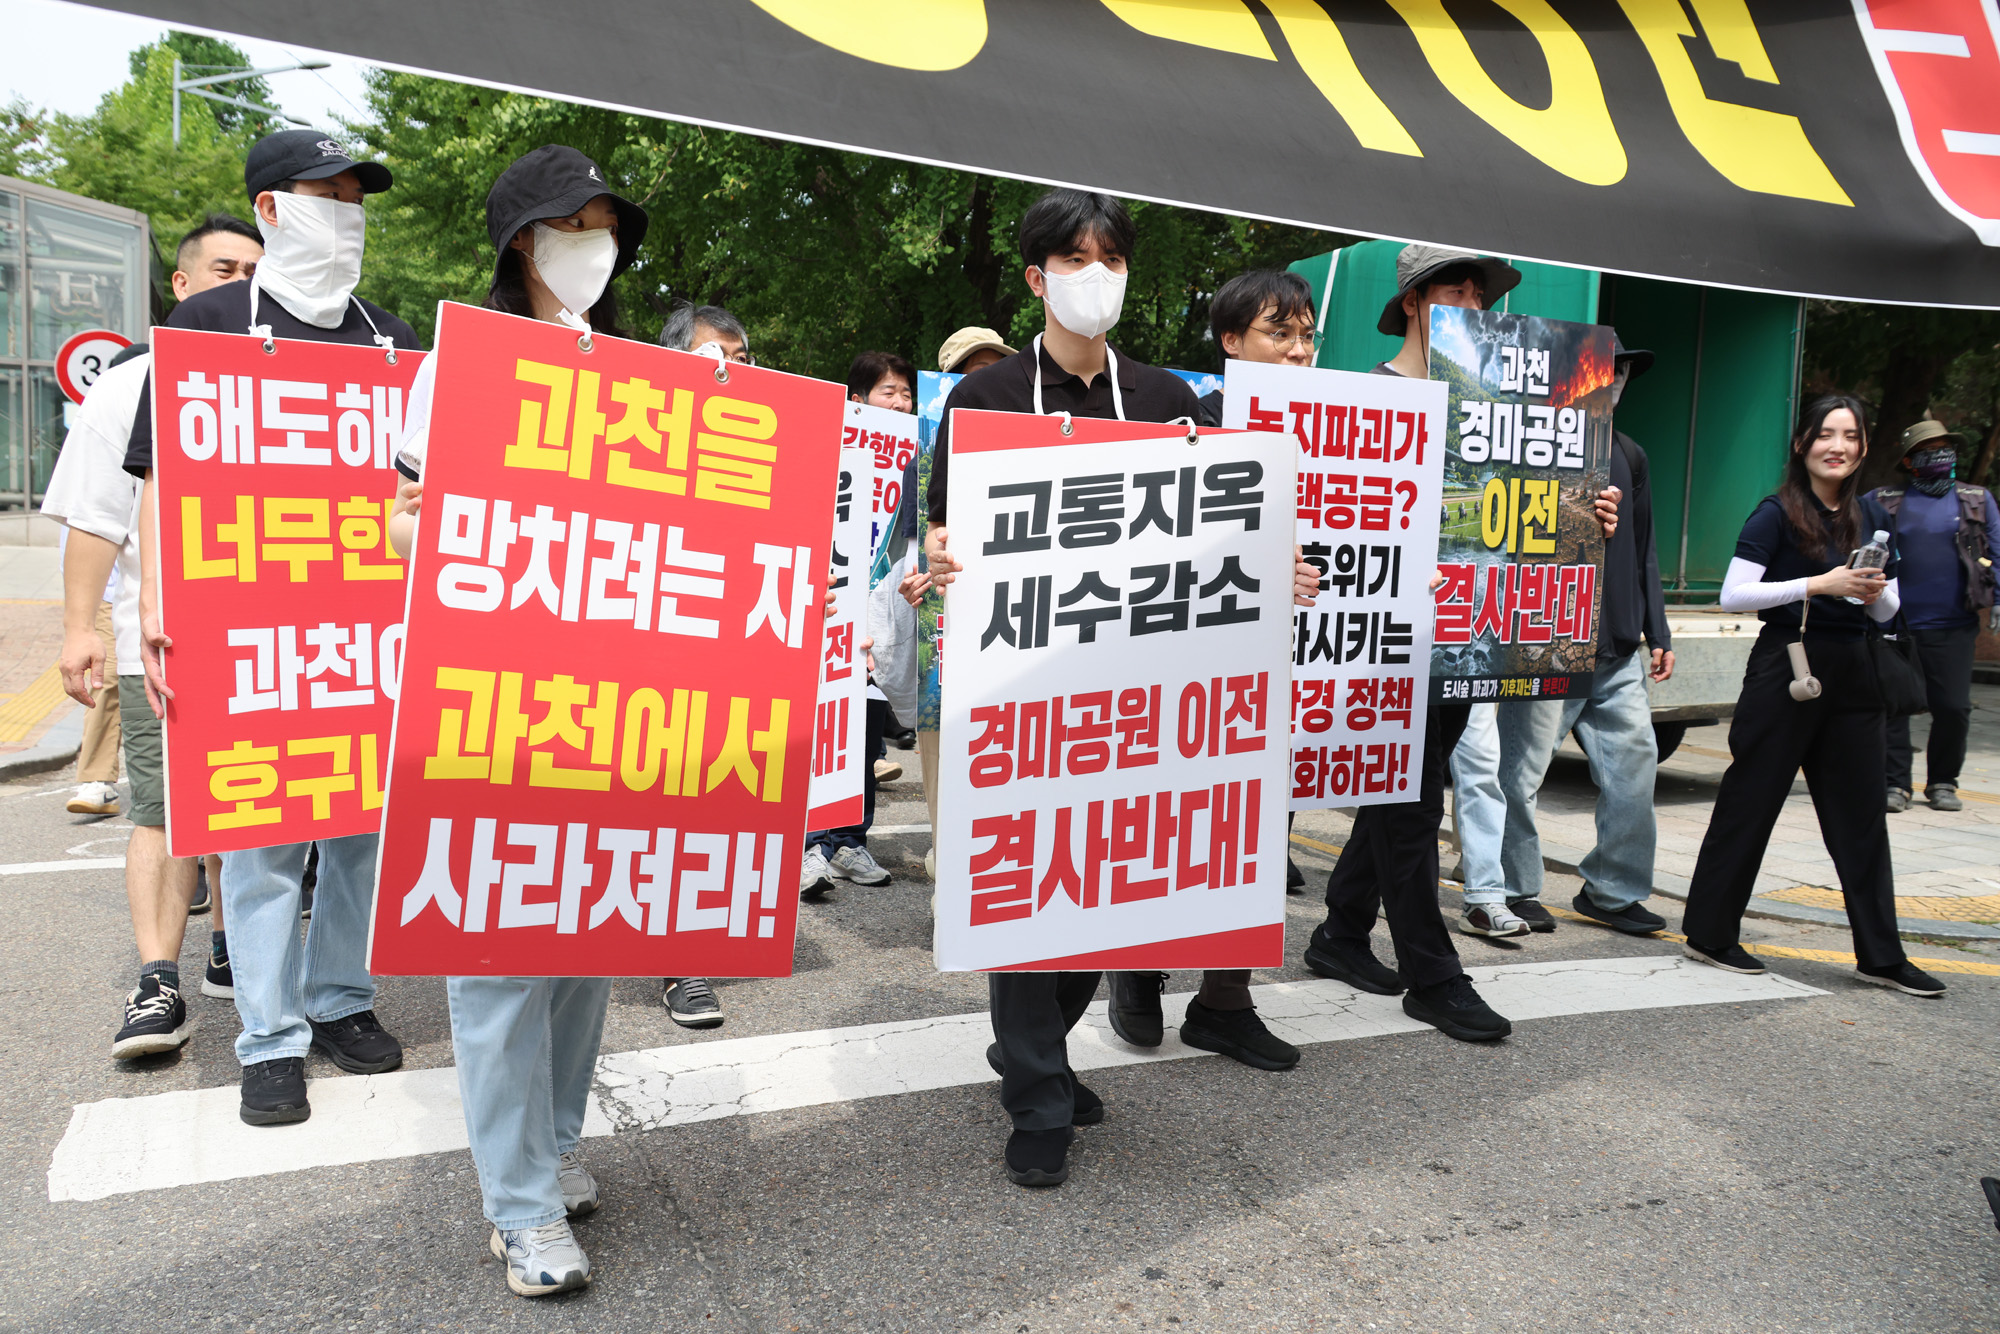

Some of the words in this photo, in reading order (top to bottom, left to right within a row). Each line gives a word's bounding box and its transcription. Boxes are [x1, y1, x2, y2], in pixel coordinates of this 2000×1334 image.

[1499, 346, 1550, 395] 과천
[177, 371, 411, 470] 해도해
[504, 358, 778, 510] 과천을
[1459, 400, 1586, 468] 경마공원
[181, 495, 404, 582] 너무한
[982, 460, 1264, 556] 교통지옥
[1481, 478, 1560, 554] 이전
[436, 493, 725, 639] 망치려는
[745, 542, 814, 649] 자
[980, 555, 1260, 652] 세수감소
[1433, 563, 1596, 644] 결사반대
[423, 666, 791, 802] 과천에서
[968, 684, 1161, 788] 경마공원
[1177, 671, 1269, 759] 이전
[1346, 677, 1414, 731] 정책
[1442, 680, 1470, 698] 도시숲
[1471, 679, 1498, 697] 파괴가
[1290, 743, 1411, 799] 화하라!
[400, 817, 784, 938] 사라져라!
[969, 778, 1261, 927] 결사반대!
